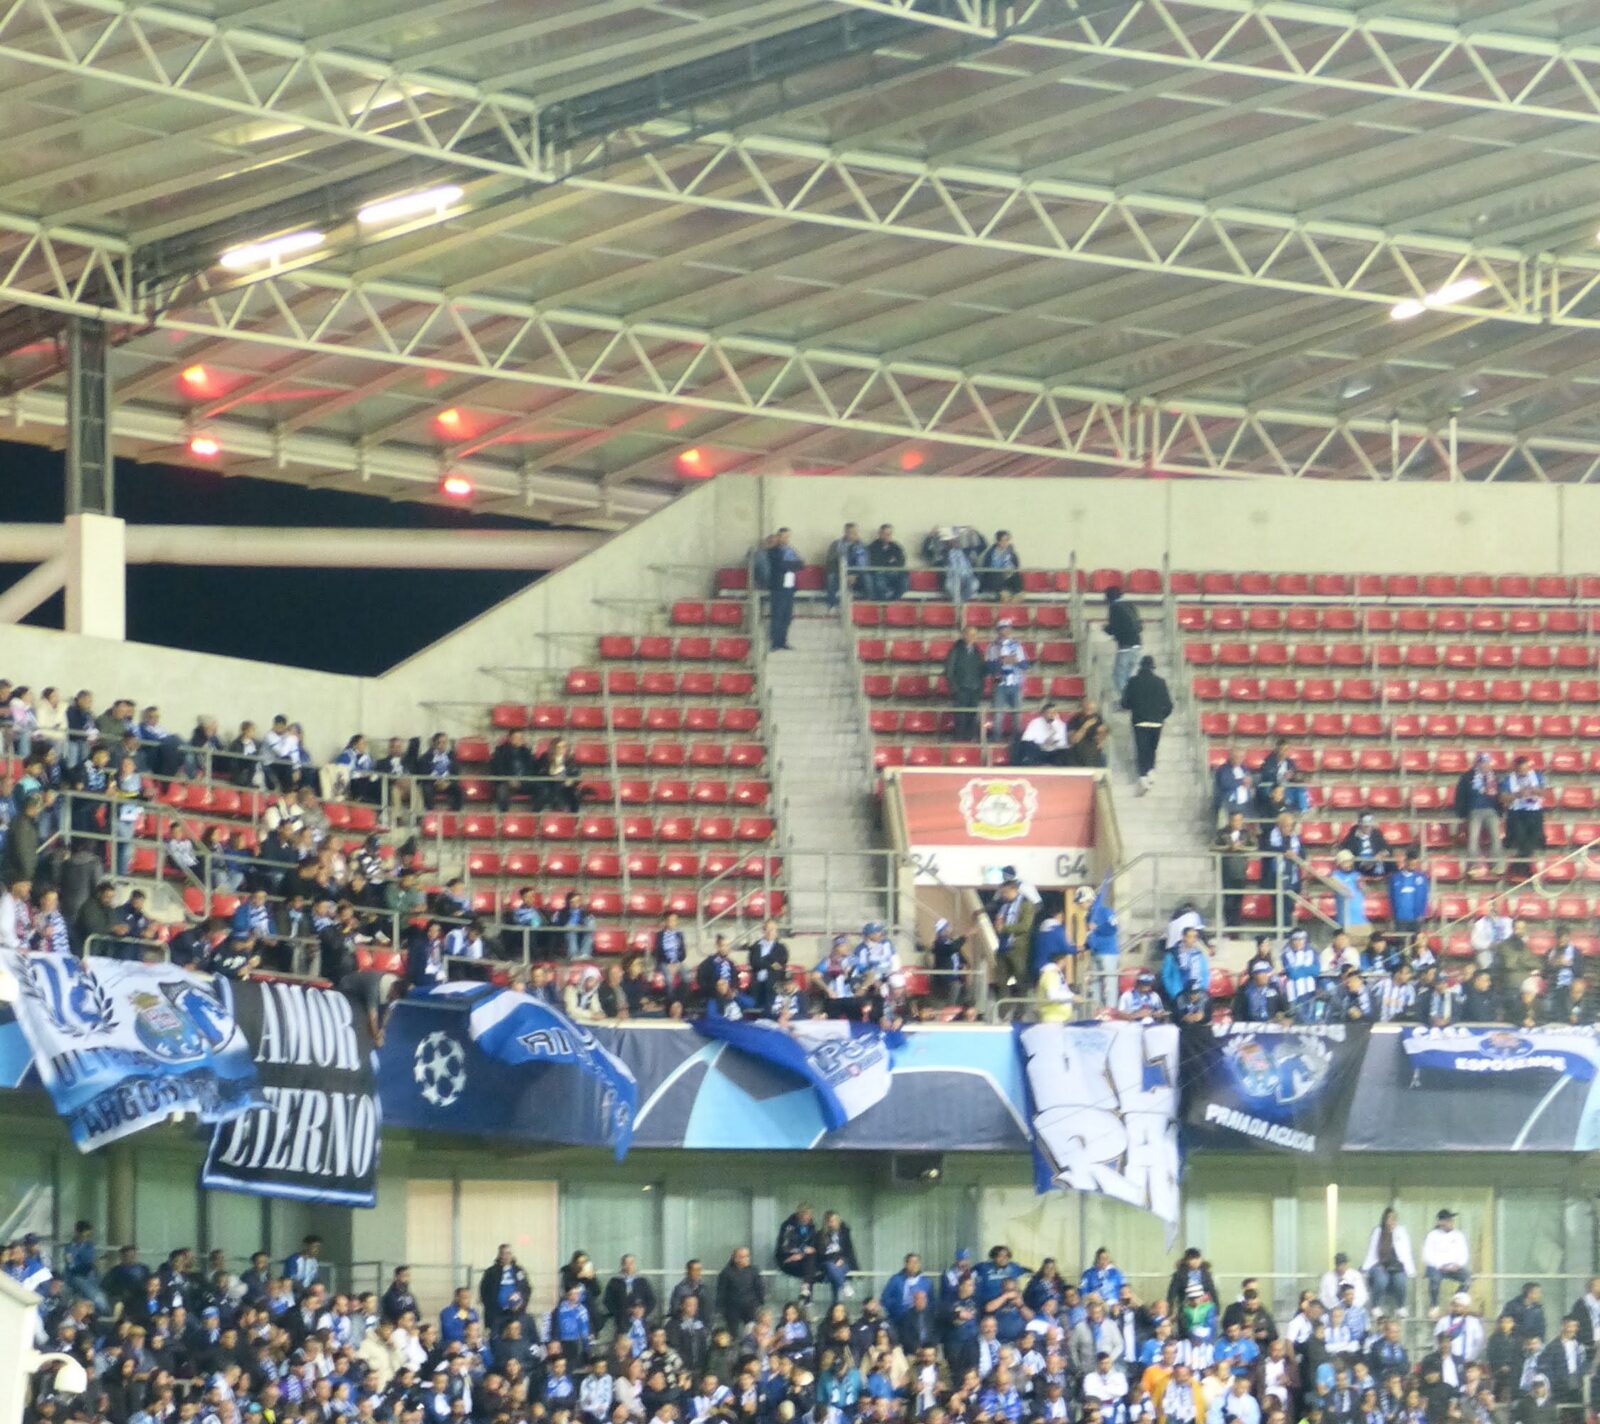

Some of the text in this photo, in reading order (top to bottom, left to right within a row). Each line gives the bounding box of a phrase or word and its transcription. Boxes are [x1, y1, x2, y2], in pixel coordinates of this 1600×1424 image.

[1056, 854, 1088, 878] G4
[254, 981, 361, 1072] AMOR
[219, 1087, 376, 1178] ETERNO
